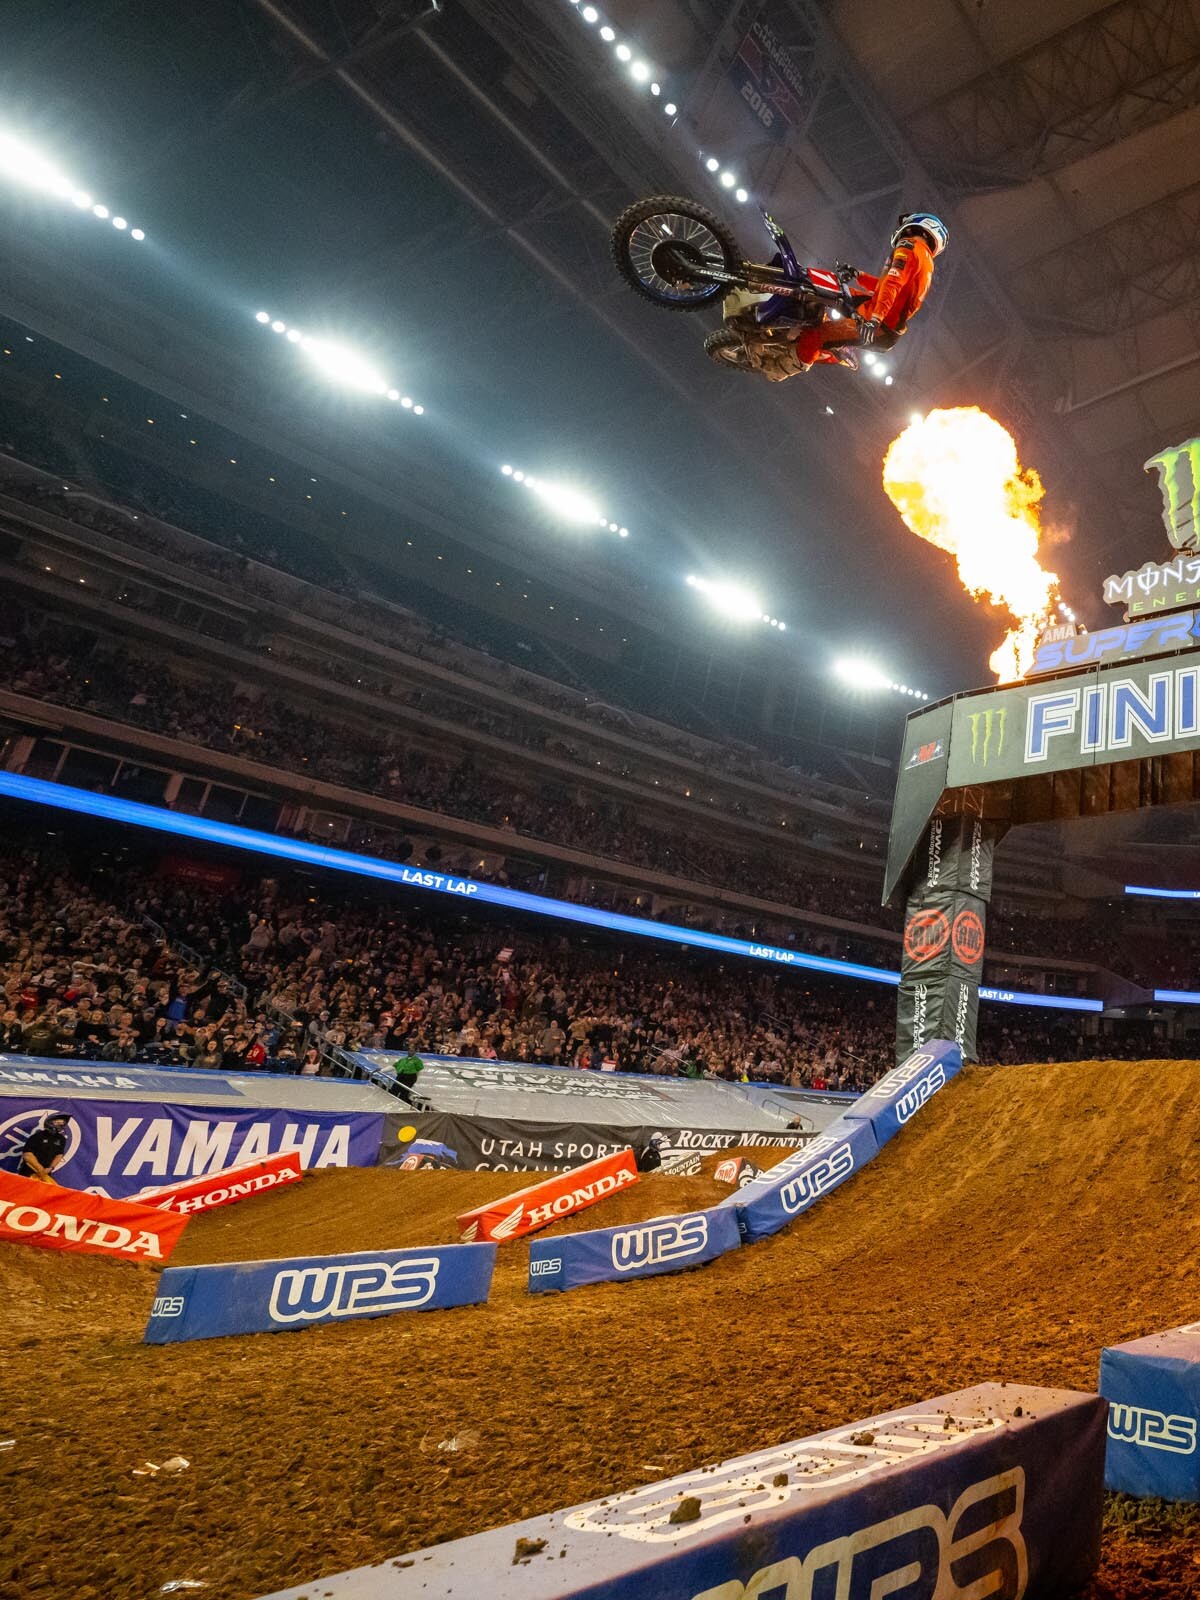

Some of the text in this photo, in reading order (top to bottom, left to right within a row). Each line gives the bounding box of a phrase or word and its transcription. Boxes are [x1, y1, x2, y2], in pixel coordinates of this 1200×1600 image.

[741, 80, 775, 128] 2016
[1042, 624, 1076, 643] AMA
[402, 869, 478, 895] LAST LAP
[749, 944, 795, 962] LAST LAP
[978, 989, 1014, 1001] LAST LAP
[870, 1053, 935, 1098] WPS
[895, 1063, 946, 1124] WPS
[90, 1116, 351, 1177] YAMAHA
[481, 1138, 543, 1158] UTAH
[675, 1129, 736, 1149] ROCKY
[176, 1167, 300, 1215] HONDA
[527, 1166, 636, 1226] HONDA
[780, 1143, 855, 1214] WPS
[530, 1257, 562, 1276] WPS
[611, 1215, 708, 1272] WPS
[151, 1296, 185, 1317] WPS
[268, 1256, 440, 1324] WPS
[1106, 1401, 1198, 1455] WPS
